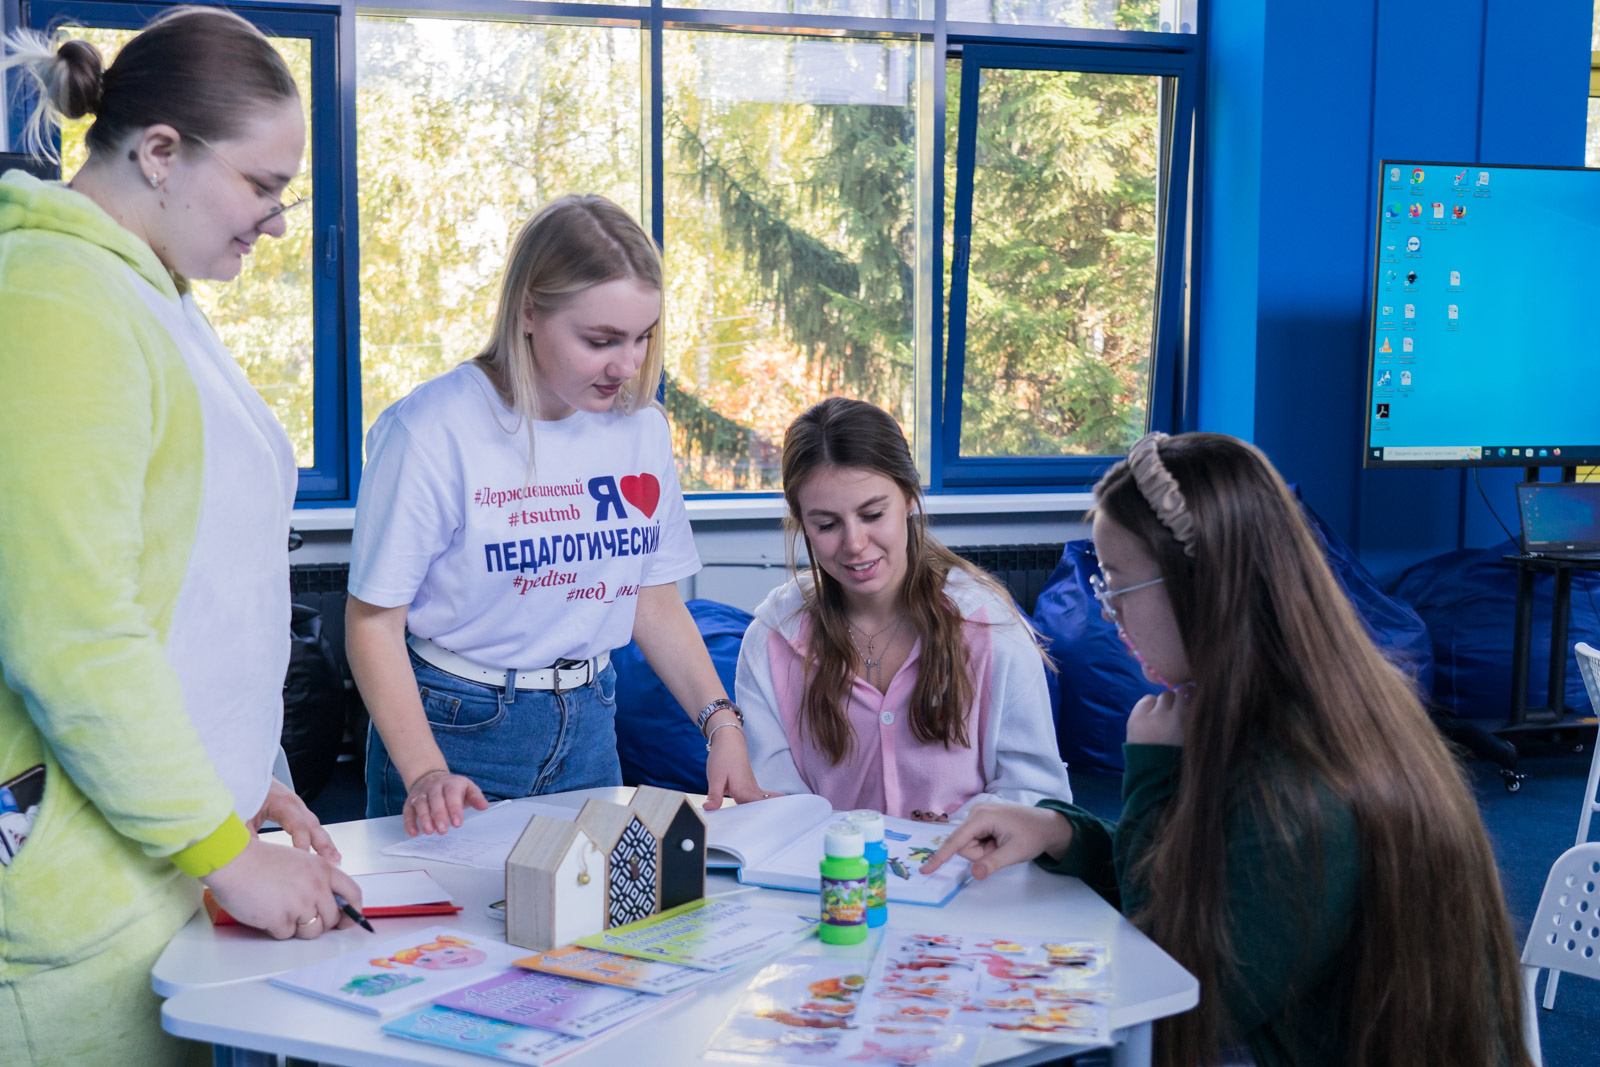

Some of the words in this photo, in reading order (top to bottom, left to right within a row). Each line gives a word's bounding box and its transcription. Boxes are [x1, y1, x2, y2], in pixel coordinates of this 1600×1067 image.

[508, 503, 581, 527] #tsutmb
[588, 475, 628, 522] Я
[484, 519, 660, 574] ПЕДАГОГИЧЕСКИЙ
[512, 569, 578, 595] #pedtsu
